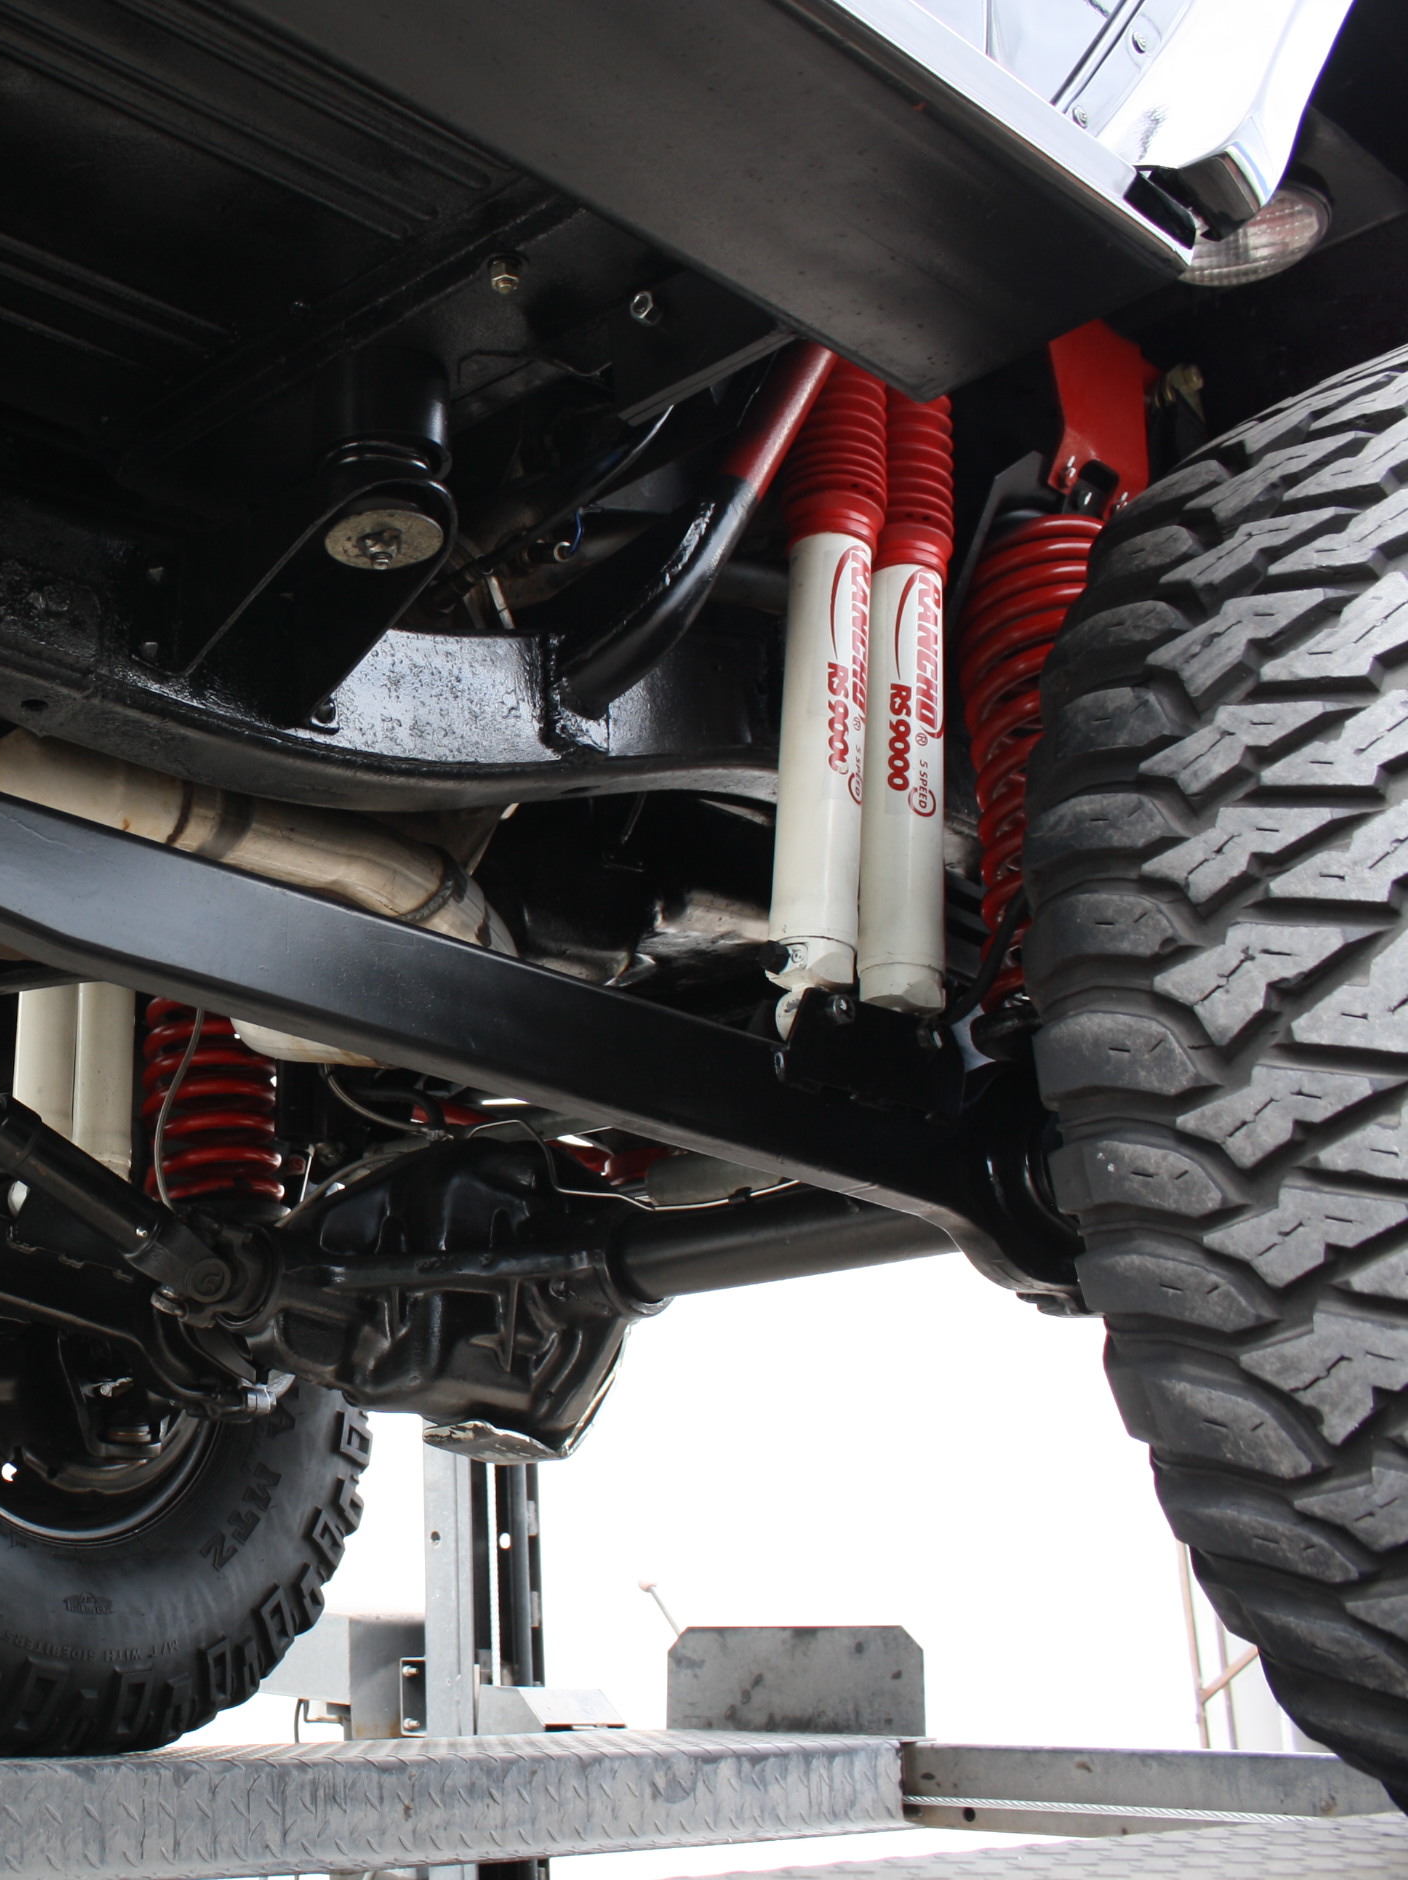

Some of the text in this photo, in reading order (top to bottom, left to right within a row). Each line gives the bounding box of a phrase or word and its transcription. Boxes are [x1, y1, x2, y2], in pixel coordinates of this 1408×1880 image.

[852, 553, 870, 714] RANCHO
[916, 573, 942, 730] RANCHO
[917, 770, 929, 810] SPEED
[198, 1461, 281, 1573] MTZ
[0, 1629, 97, 1663] SIDEBITERS
[104, 1647, 141, 1663] WITH
